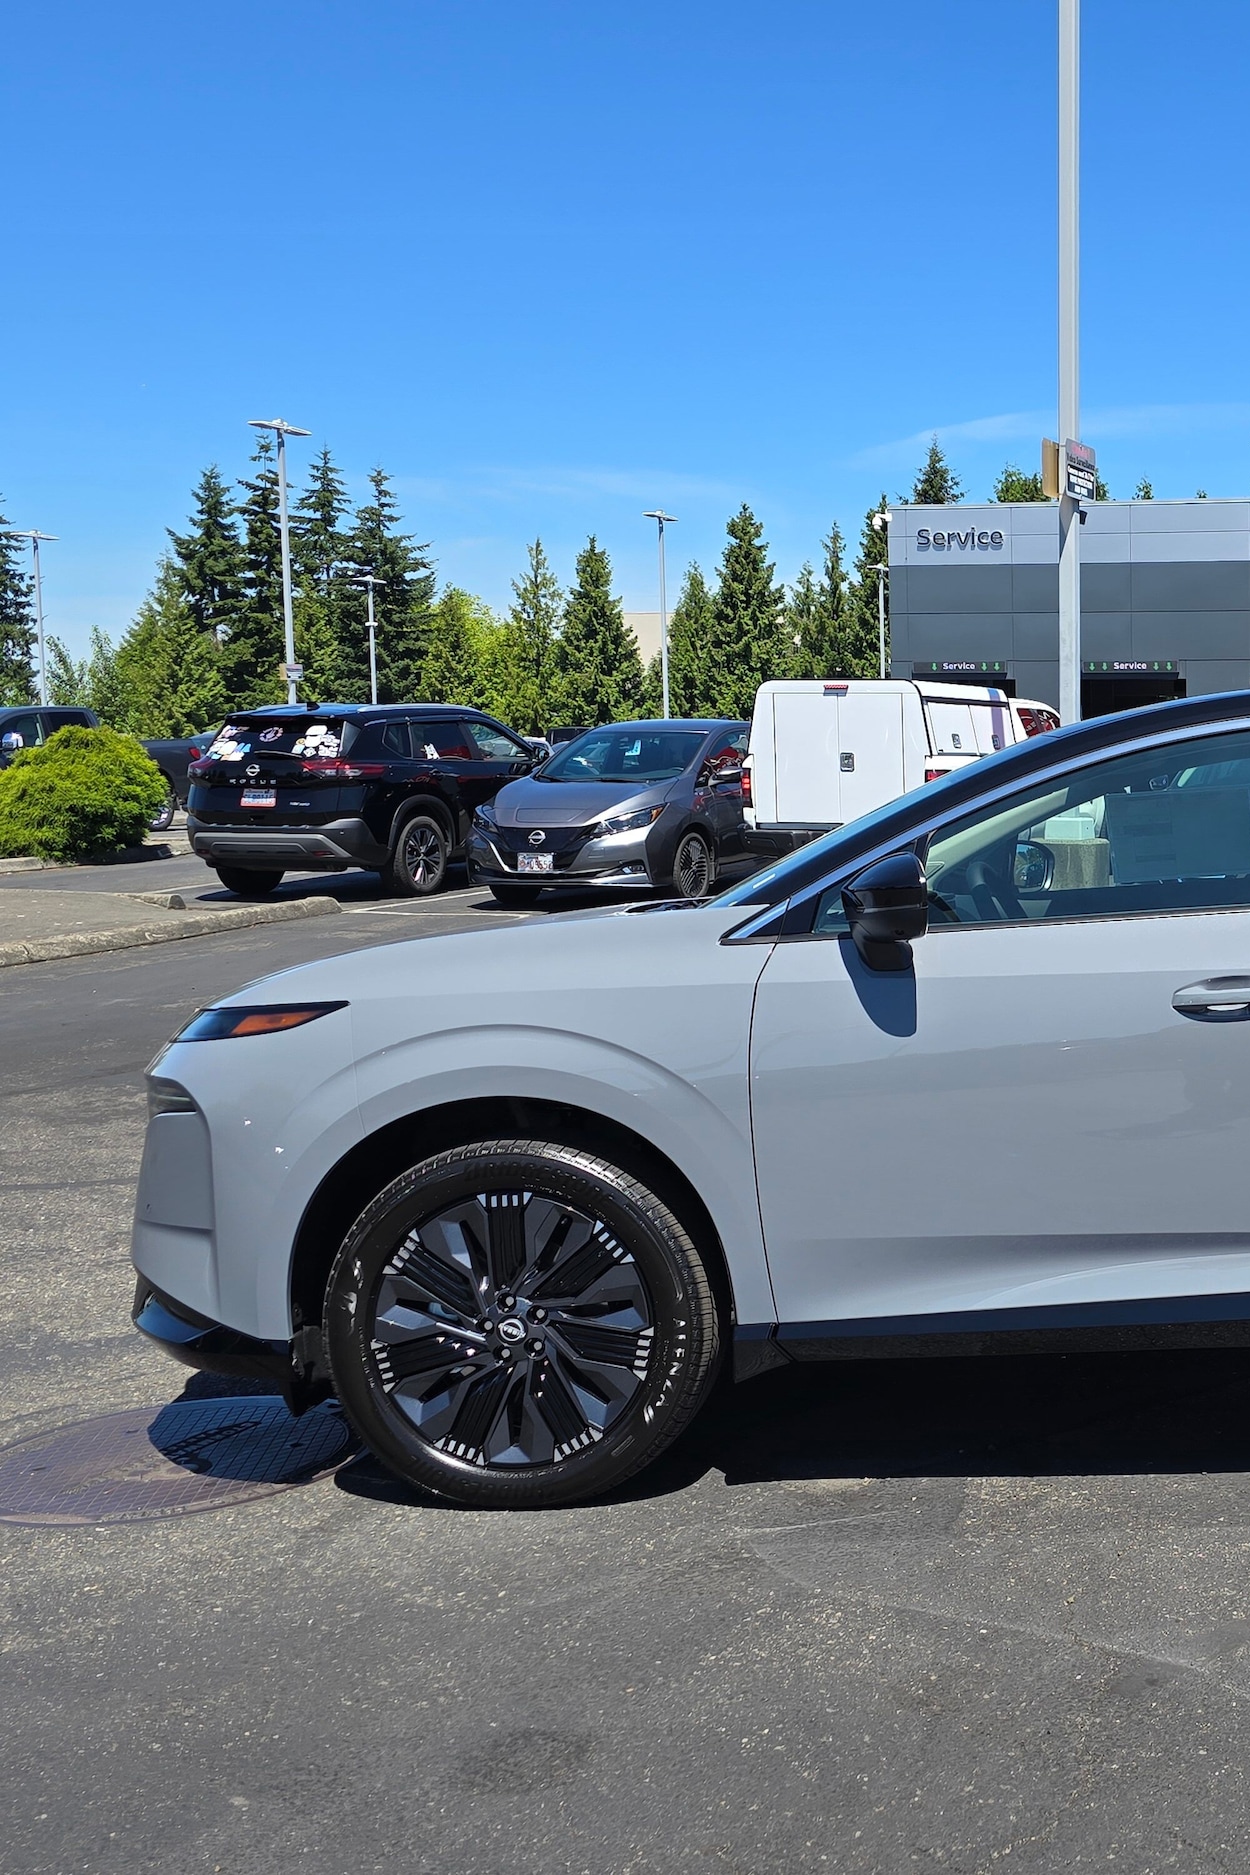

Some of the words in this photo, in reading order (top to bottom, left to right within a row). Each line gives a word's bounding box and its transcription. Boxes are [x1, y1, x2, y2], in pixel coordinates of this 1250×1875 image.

[917, 527, 1003, 546] Service
[942, 661, 976, 670] Service
[1113, 661, 1147, 670] Service
